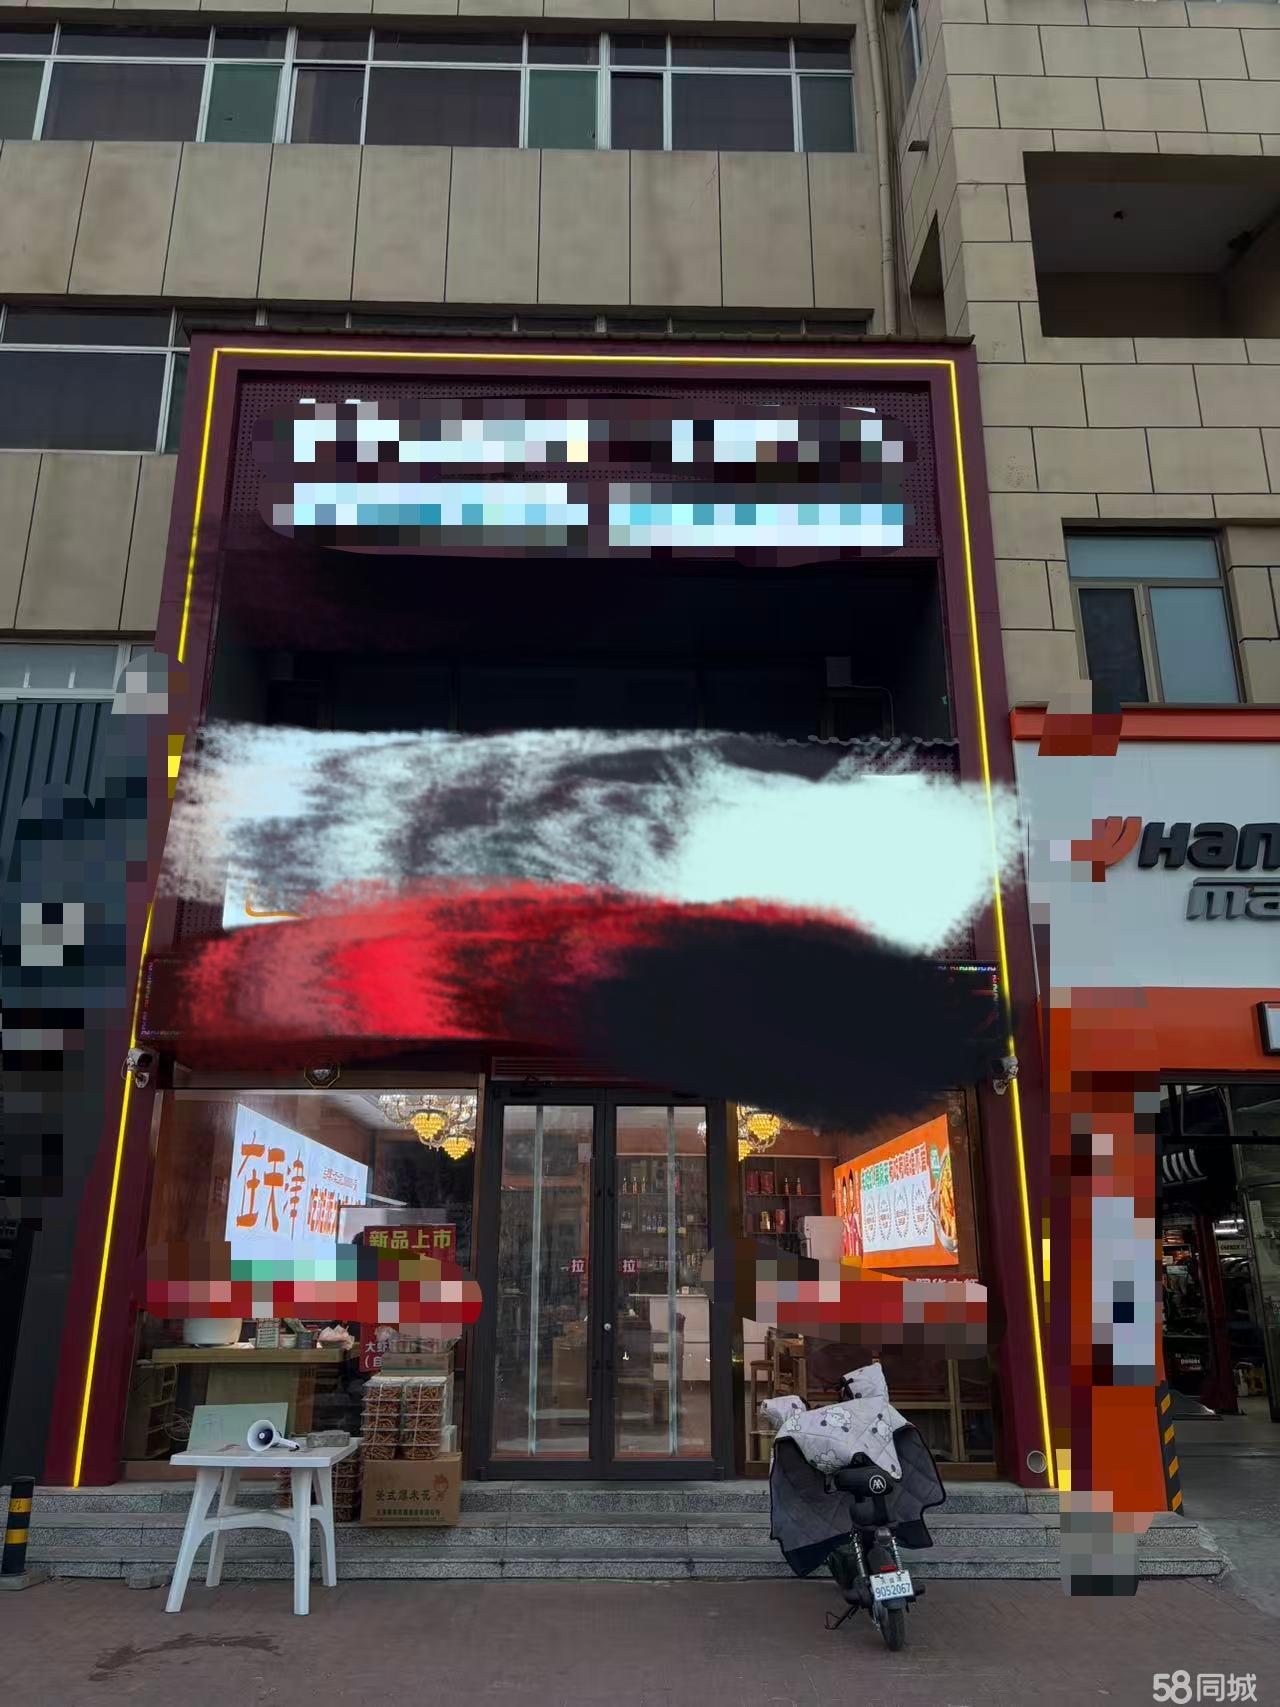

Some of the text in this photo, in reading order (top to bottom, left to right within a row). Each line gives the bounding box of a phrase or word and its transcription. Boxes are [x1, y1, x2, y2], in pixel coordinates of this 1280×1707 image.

[236, 1130, 306, 1240] 在天津
[368, 1229, 452, 1249] 新品上市
[571, 1258, 585, 1273] 拉
[622, 1258, 637, 1273] 拉
[875, 1582, 912, 1598] 9052067
